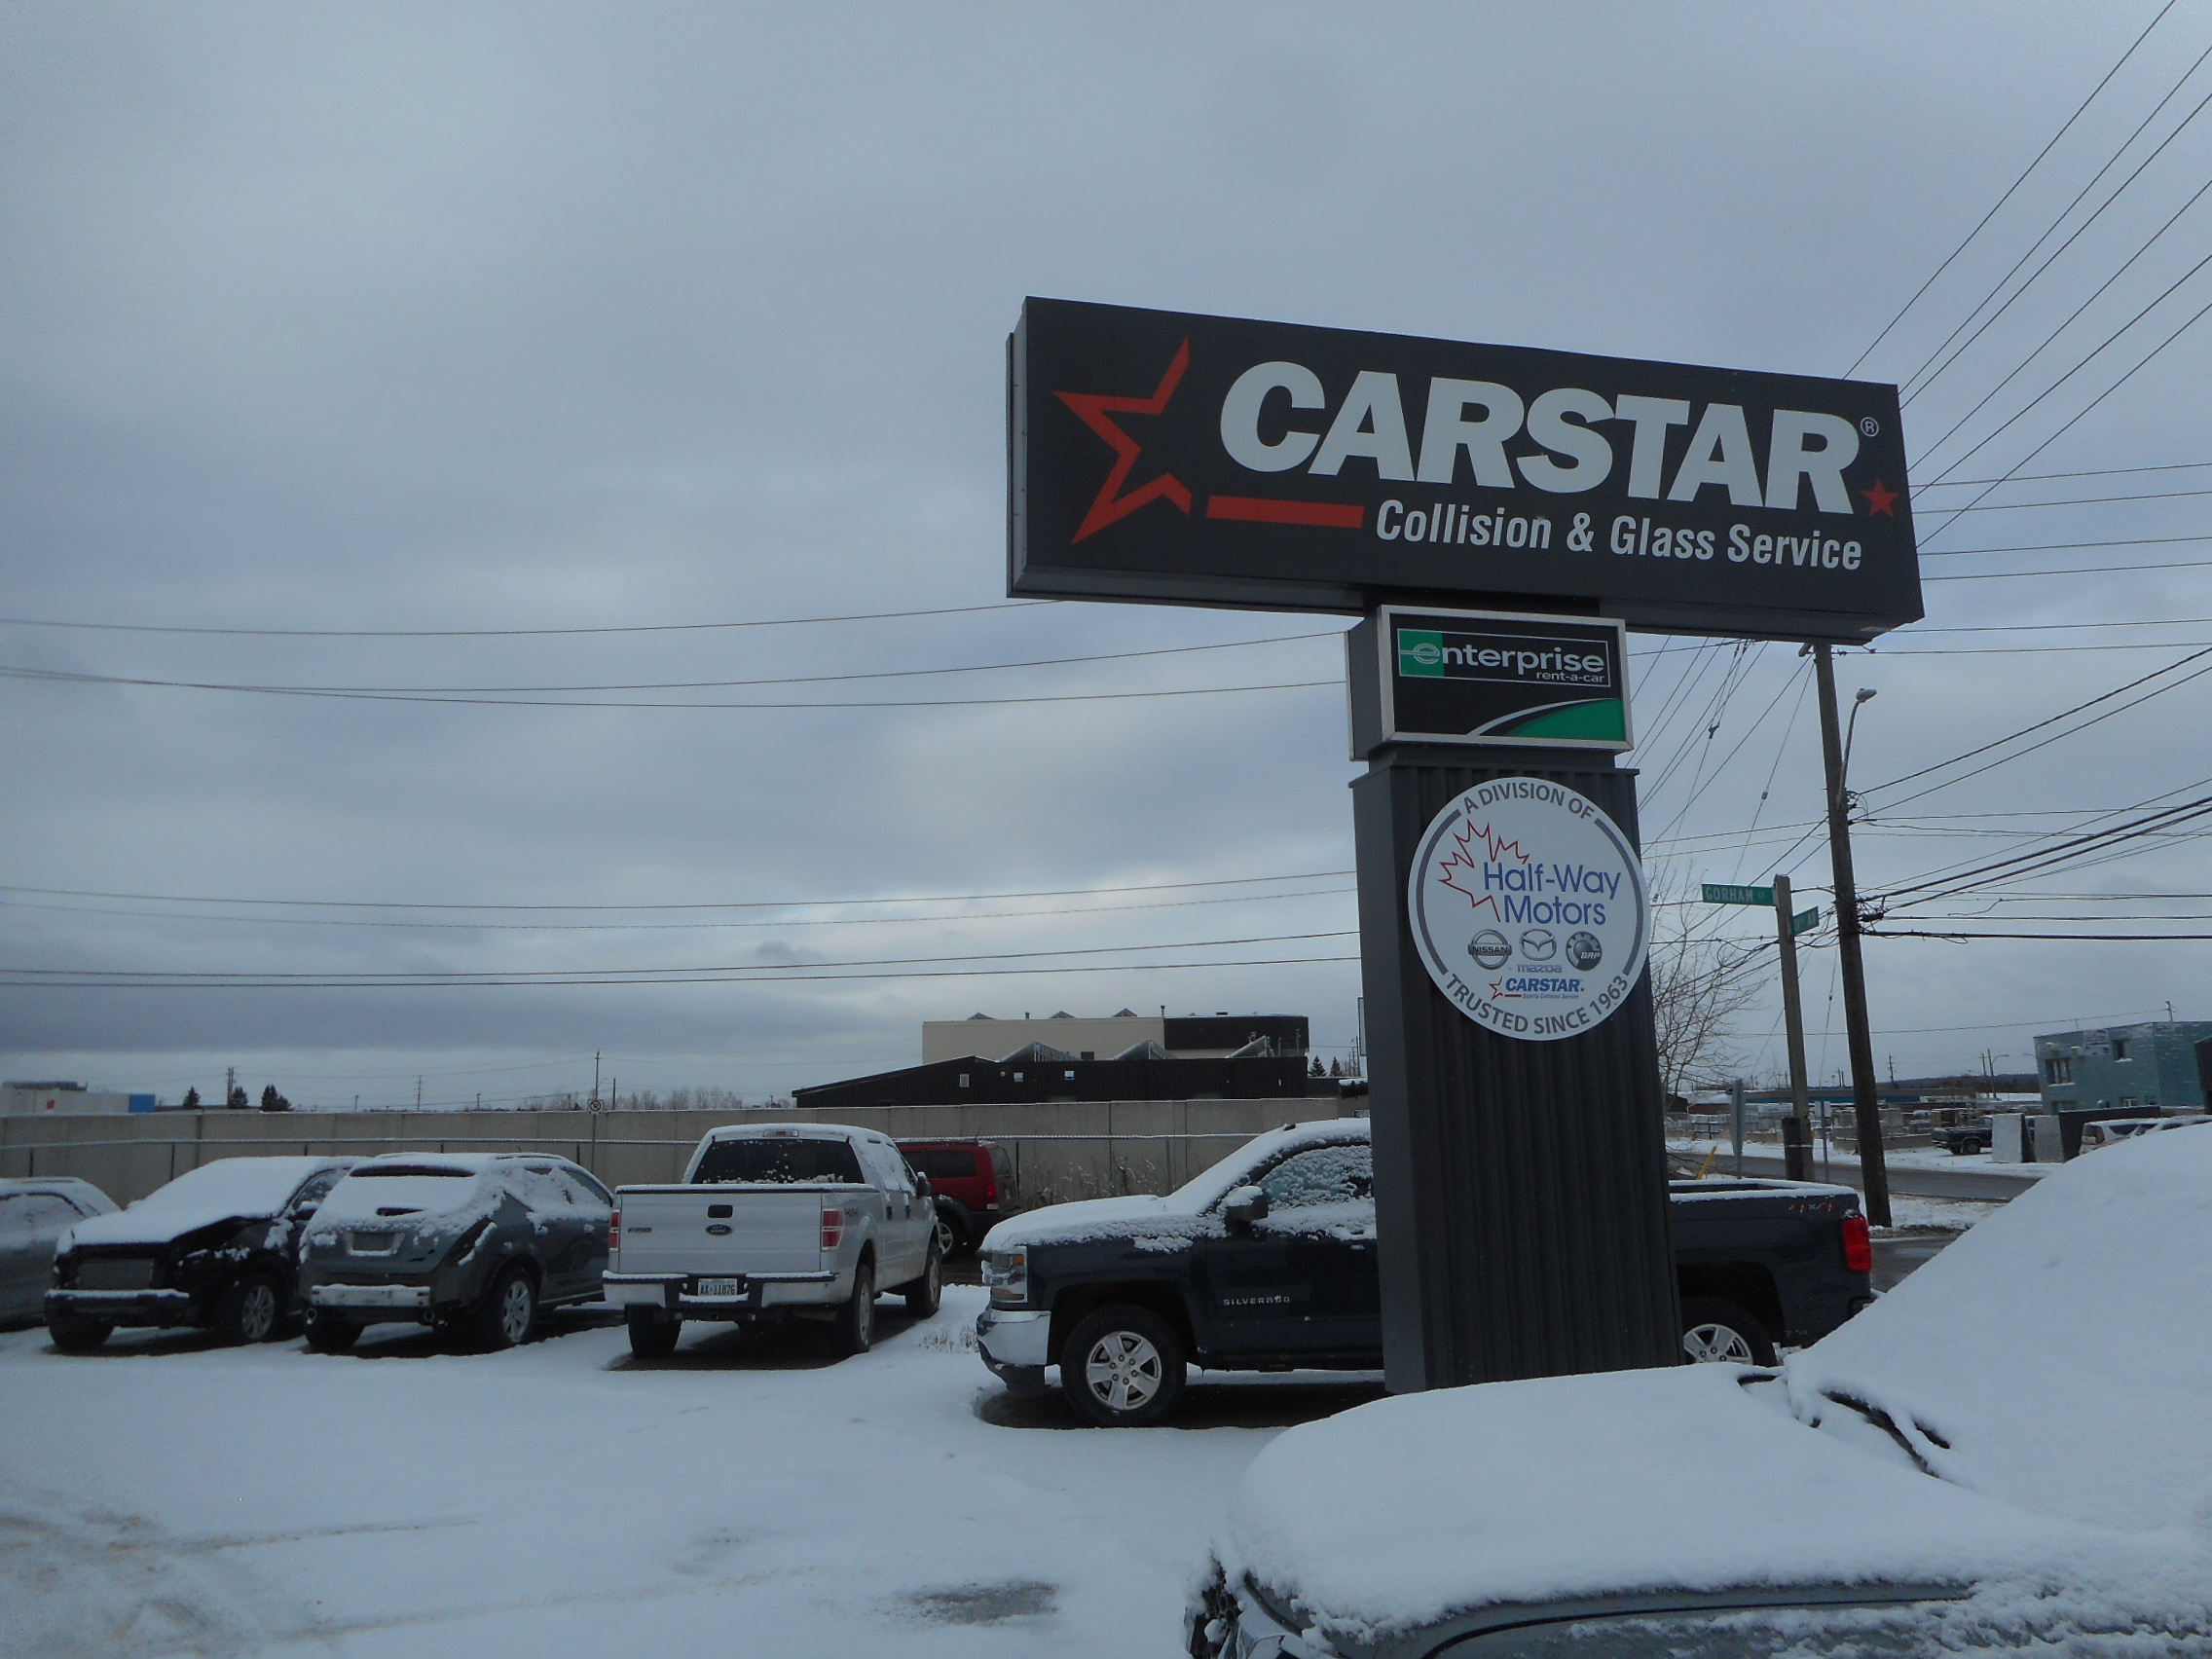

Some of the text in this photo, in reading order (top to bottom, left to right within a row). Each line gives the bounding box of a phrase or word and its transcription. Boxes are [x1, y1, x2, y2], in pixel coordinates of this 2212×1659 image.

[1220, 360, 1861, 515] CARSTAR
[1376, 499, 1862, 570] Collision & Glass Service
[1413, 643, 1604, 675] enterprise
[1536, 670, 1604, 683] rent-a-car
[1463, 782, 1595, 820] A DIVISION OF
[1484, 862, 1622, 900] Half-Way
[1706, 886, 1752, 902] GORHAM
[1504, 895, 1606, 925] Motors
[1505, 977, 1580, 992] CARSTAR
[1445, 974, 1629, 1035] TRUSTED SINCE 1963
